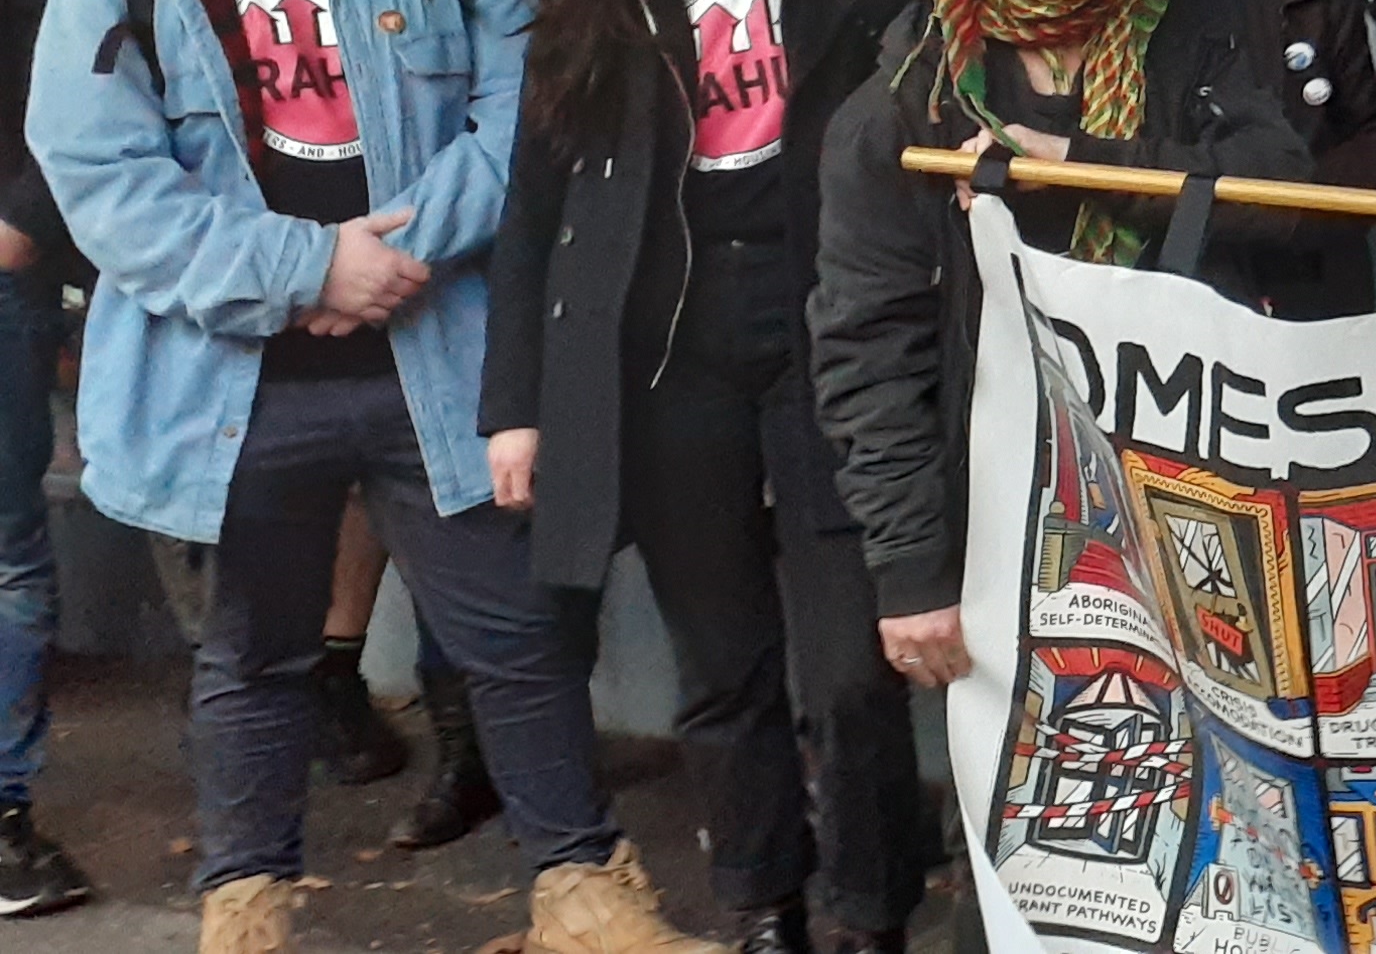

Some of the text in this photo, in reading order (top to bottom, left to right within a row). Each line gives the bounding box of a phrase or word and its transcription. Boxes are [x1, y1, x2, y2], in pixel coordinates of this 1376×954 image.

[1199, 612, 1242, 647] SHUT
[1008, 881, 1151, 914] UNDOCUMENTED
[1013, 898, 1157, 934] RANT PATHWAYS
